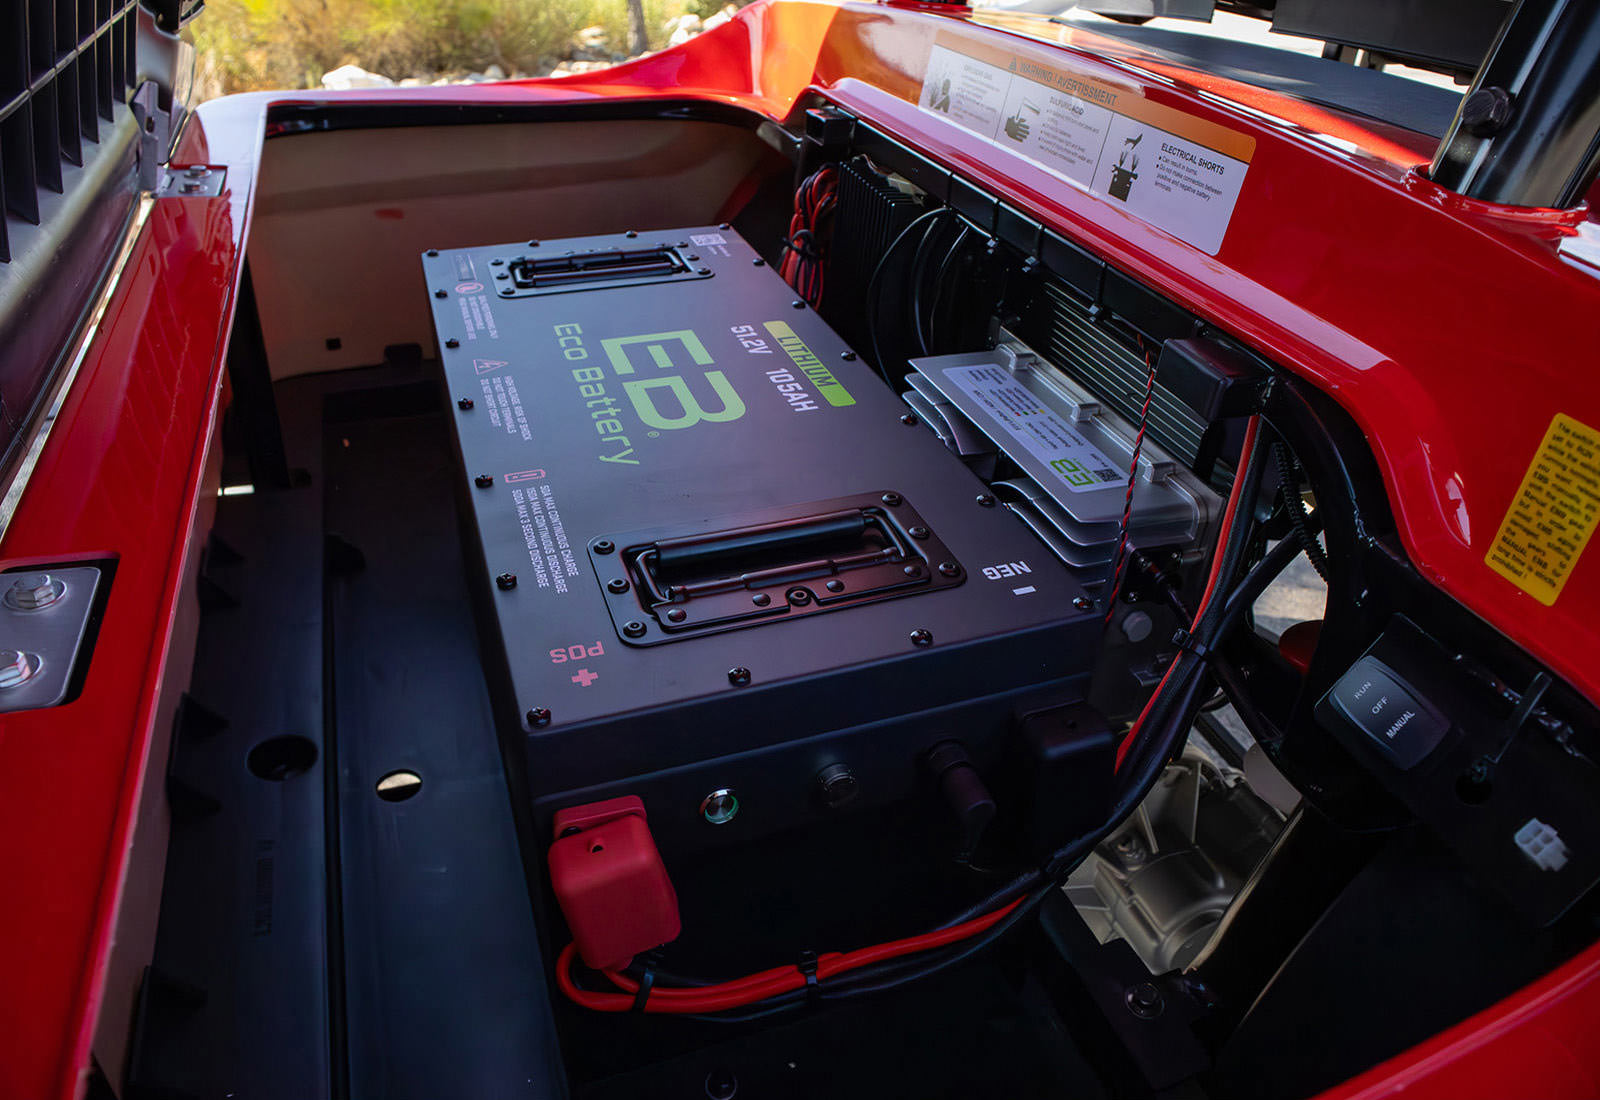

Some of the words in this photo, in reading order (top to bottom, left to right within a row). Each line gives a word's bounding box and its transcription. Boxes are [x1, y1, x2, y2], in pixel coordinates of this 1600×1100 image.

[1160, 142, 1198, 164] ELECTRICAL
[1197, 157, 1224, 175] SHORTS
[731, 324, 772, 355] 51.2V
[765, 368, 818, 412] 105AH
[776, 336, 837, 388] LITHIUM
[516, 504, 528, 518] MAX
[530, 501, 542, 514] MAX
[543, 496, 556, 510] MAX
[522, 524, 537, 549] SECOND
[534, 514, 554, 554] CONTINUOUS
[547, 510, 569, 549] CONTINUOUS
[529, 549, 548, 588] DISCHARGE
[546, 553, 568, 593] DISCHARGE
[560, 548, 578, 577] CHARGE
[982, 560, 1032, 580] NEG
[550, 641, 604, 663] POS
[1354, 681, 1372, 700] RUN
[1371, 696, 1390, 715] OFF
[1386, 710, 1415, 739] MANUAL
